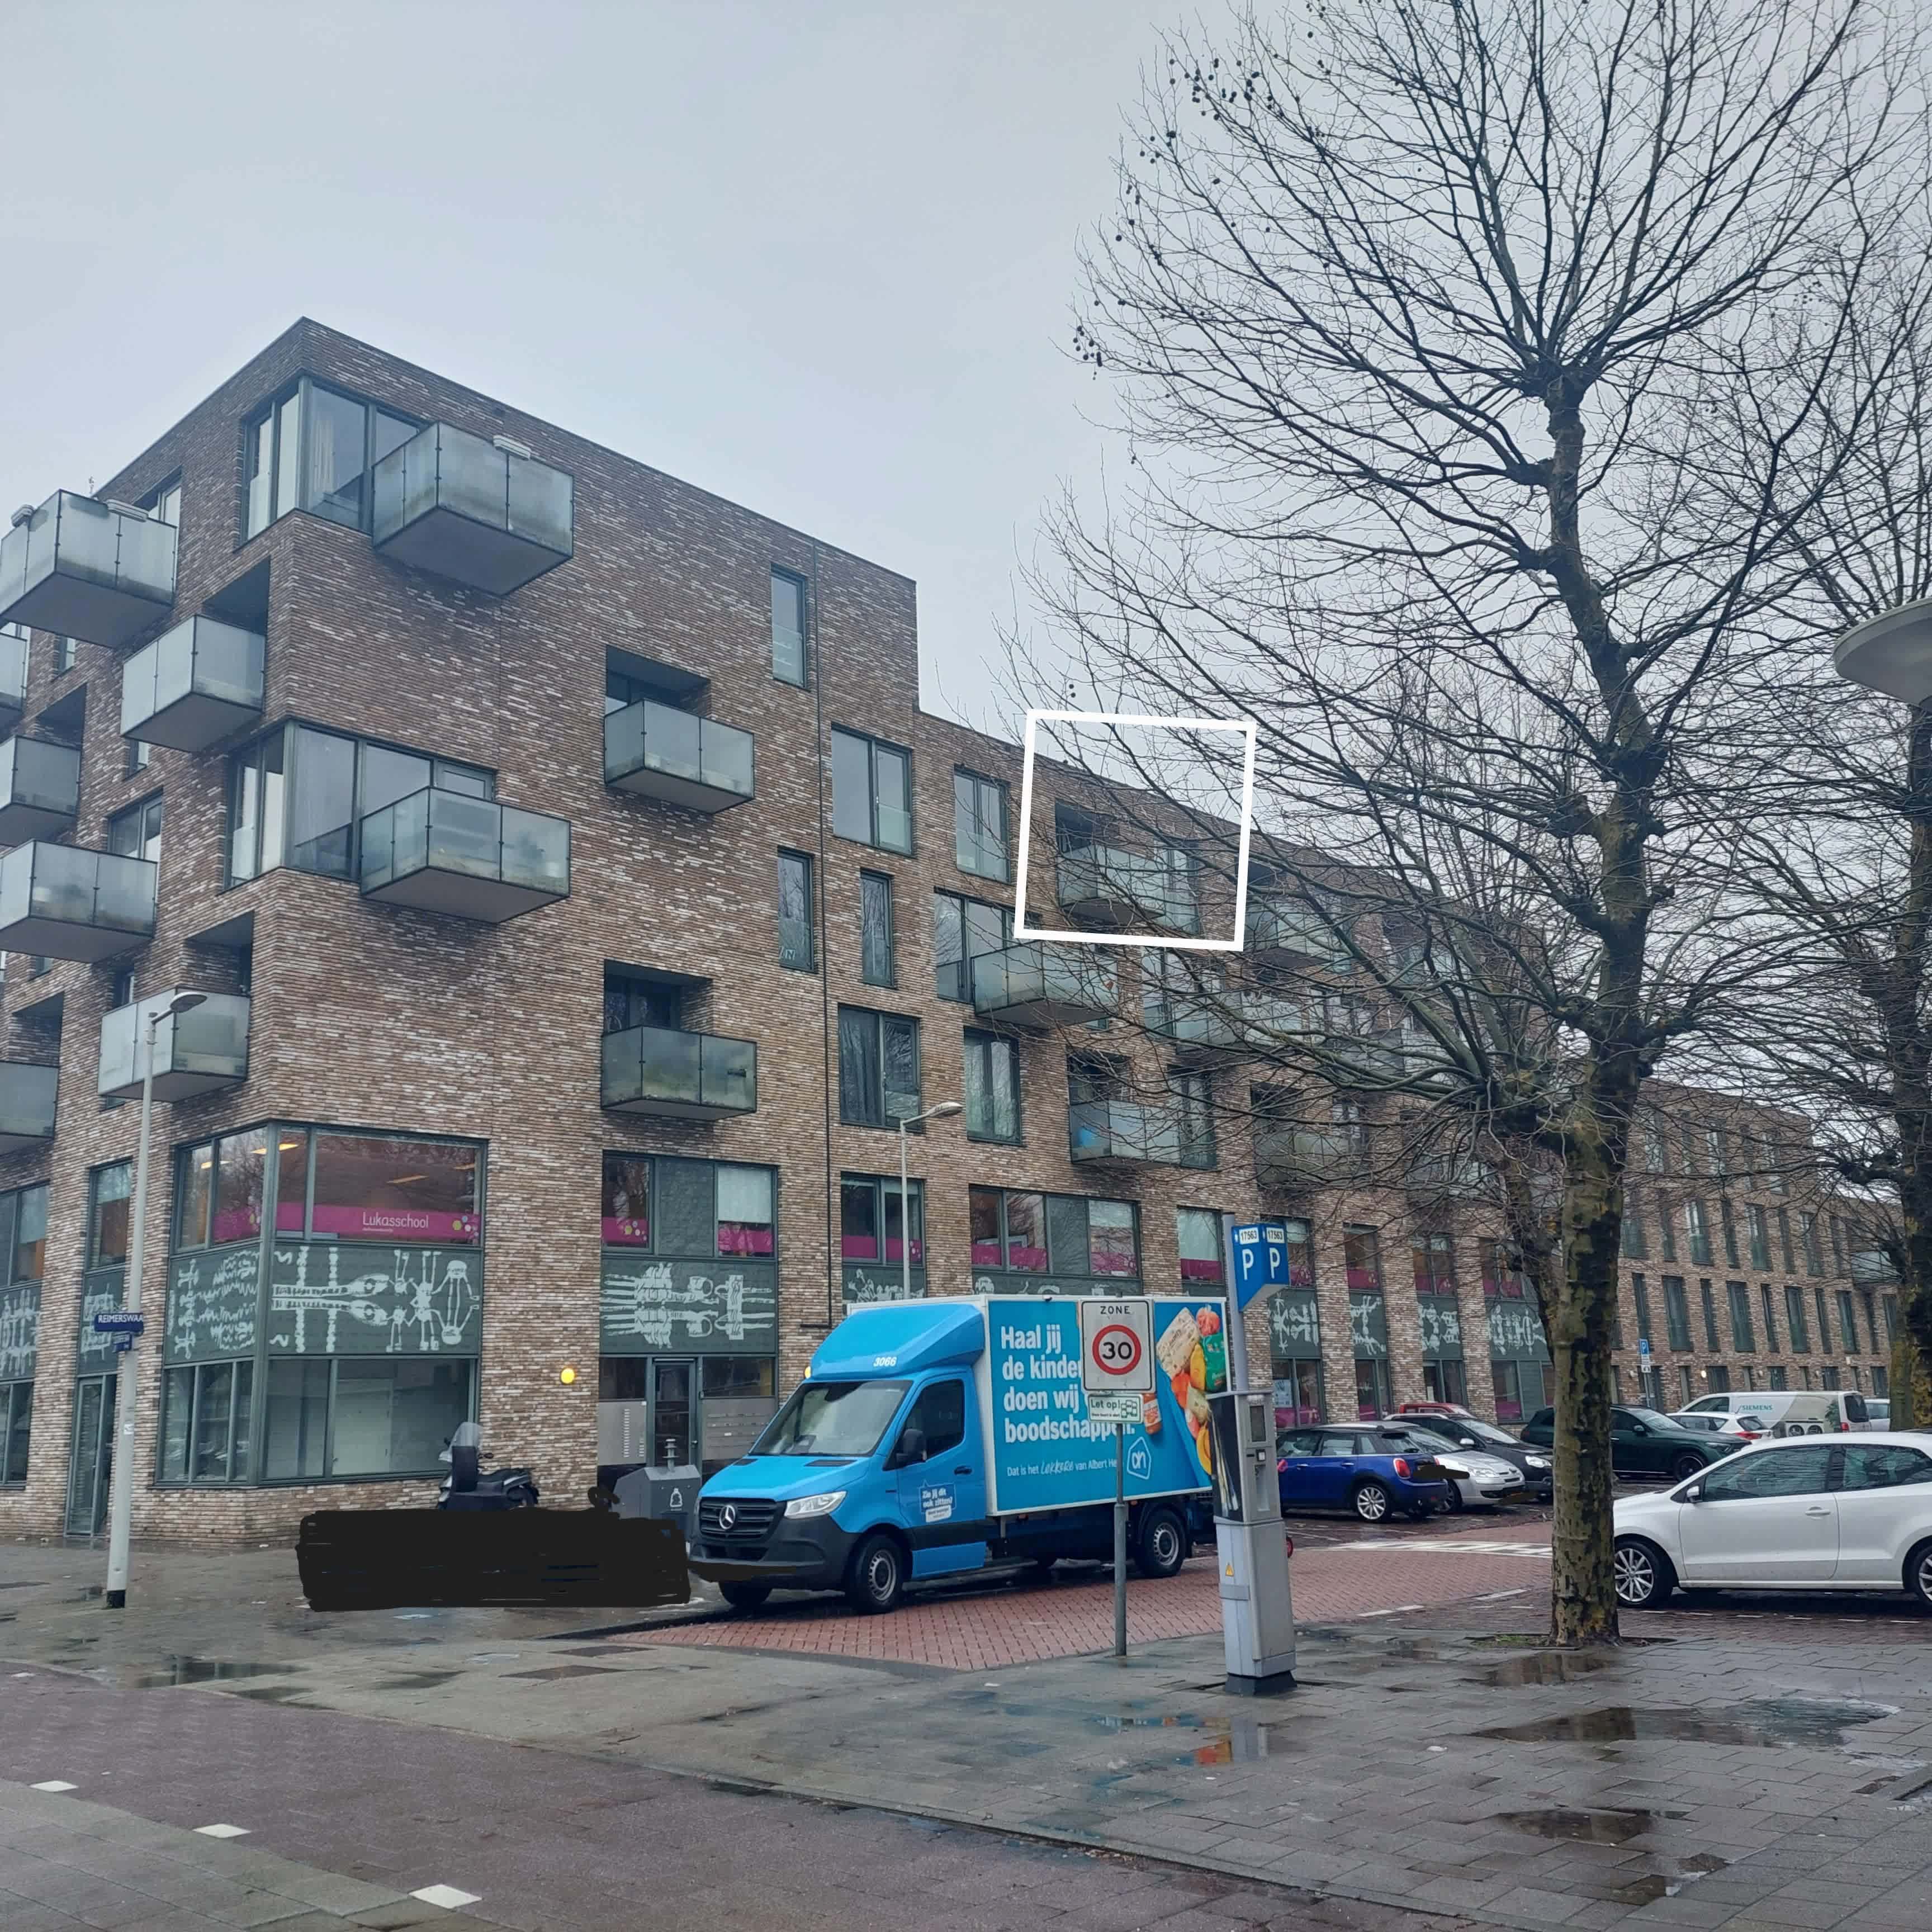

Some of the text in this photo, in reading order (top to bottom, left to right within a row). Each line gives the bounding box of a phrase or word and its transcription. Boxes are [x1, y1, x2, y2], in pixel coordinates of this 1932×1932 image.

[363, 1211, 429, 1229] Lukasschool
[1242, 1248, 1254, 1281] P
[1269, 1247, 1280, 1279] P
[1100, 1305, 1130, 1314] ZONE
[1001, 1324, 1061, 1354] Haal jij
[1102, 1342, 1132, 1360] 30
[873, 1356, 897, 1367] 3066
[1002, 1355, 1024, 1380] de
[1003, 1384, 1079, 1413] doen wij
[1091, 1399, 1120, 1410] Let op!
[1007, 1466, 1019, 1476] Dat
[1020, 1464, 1027, 1475] is
[1028, 1464, 1039, 1474] het
[1075, 1461, 1087, 1470] van
[1088, 1459, 1107, 1469] Albert
